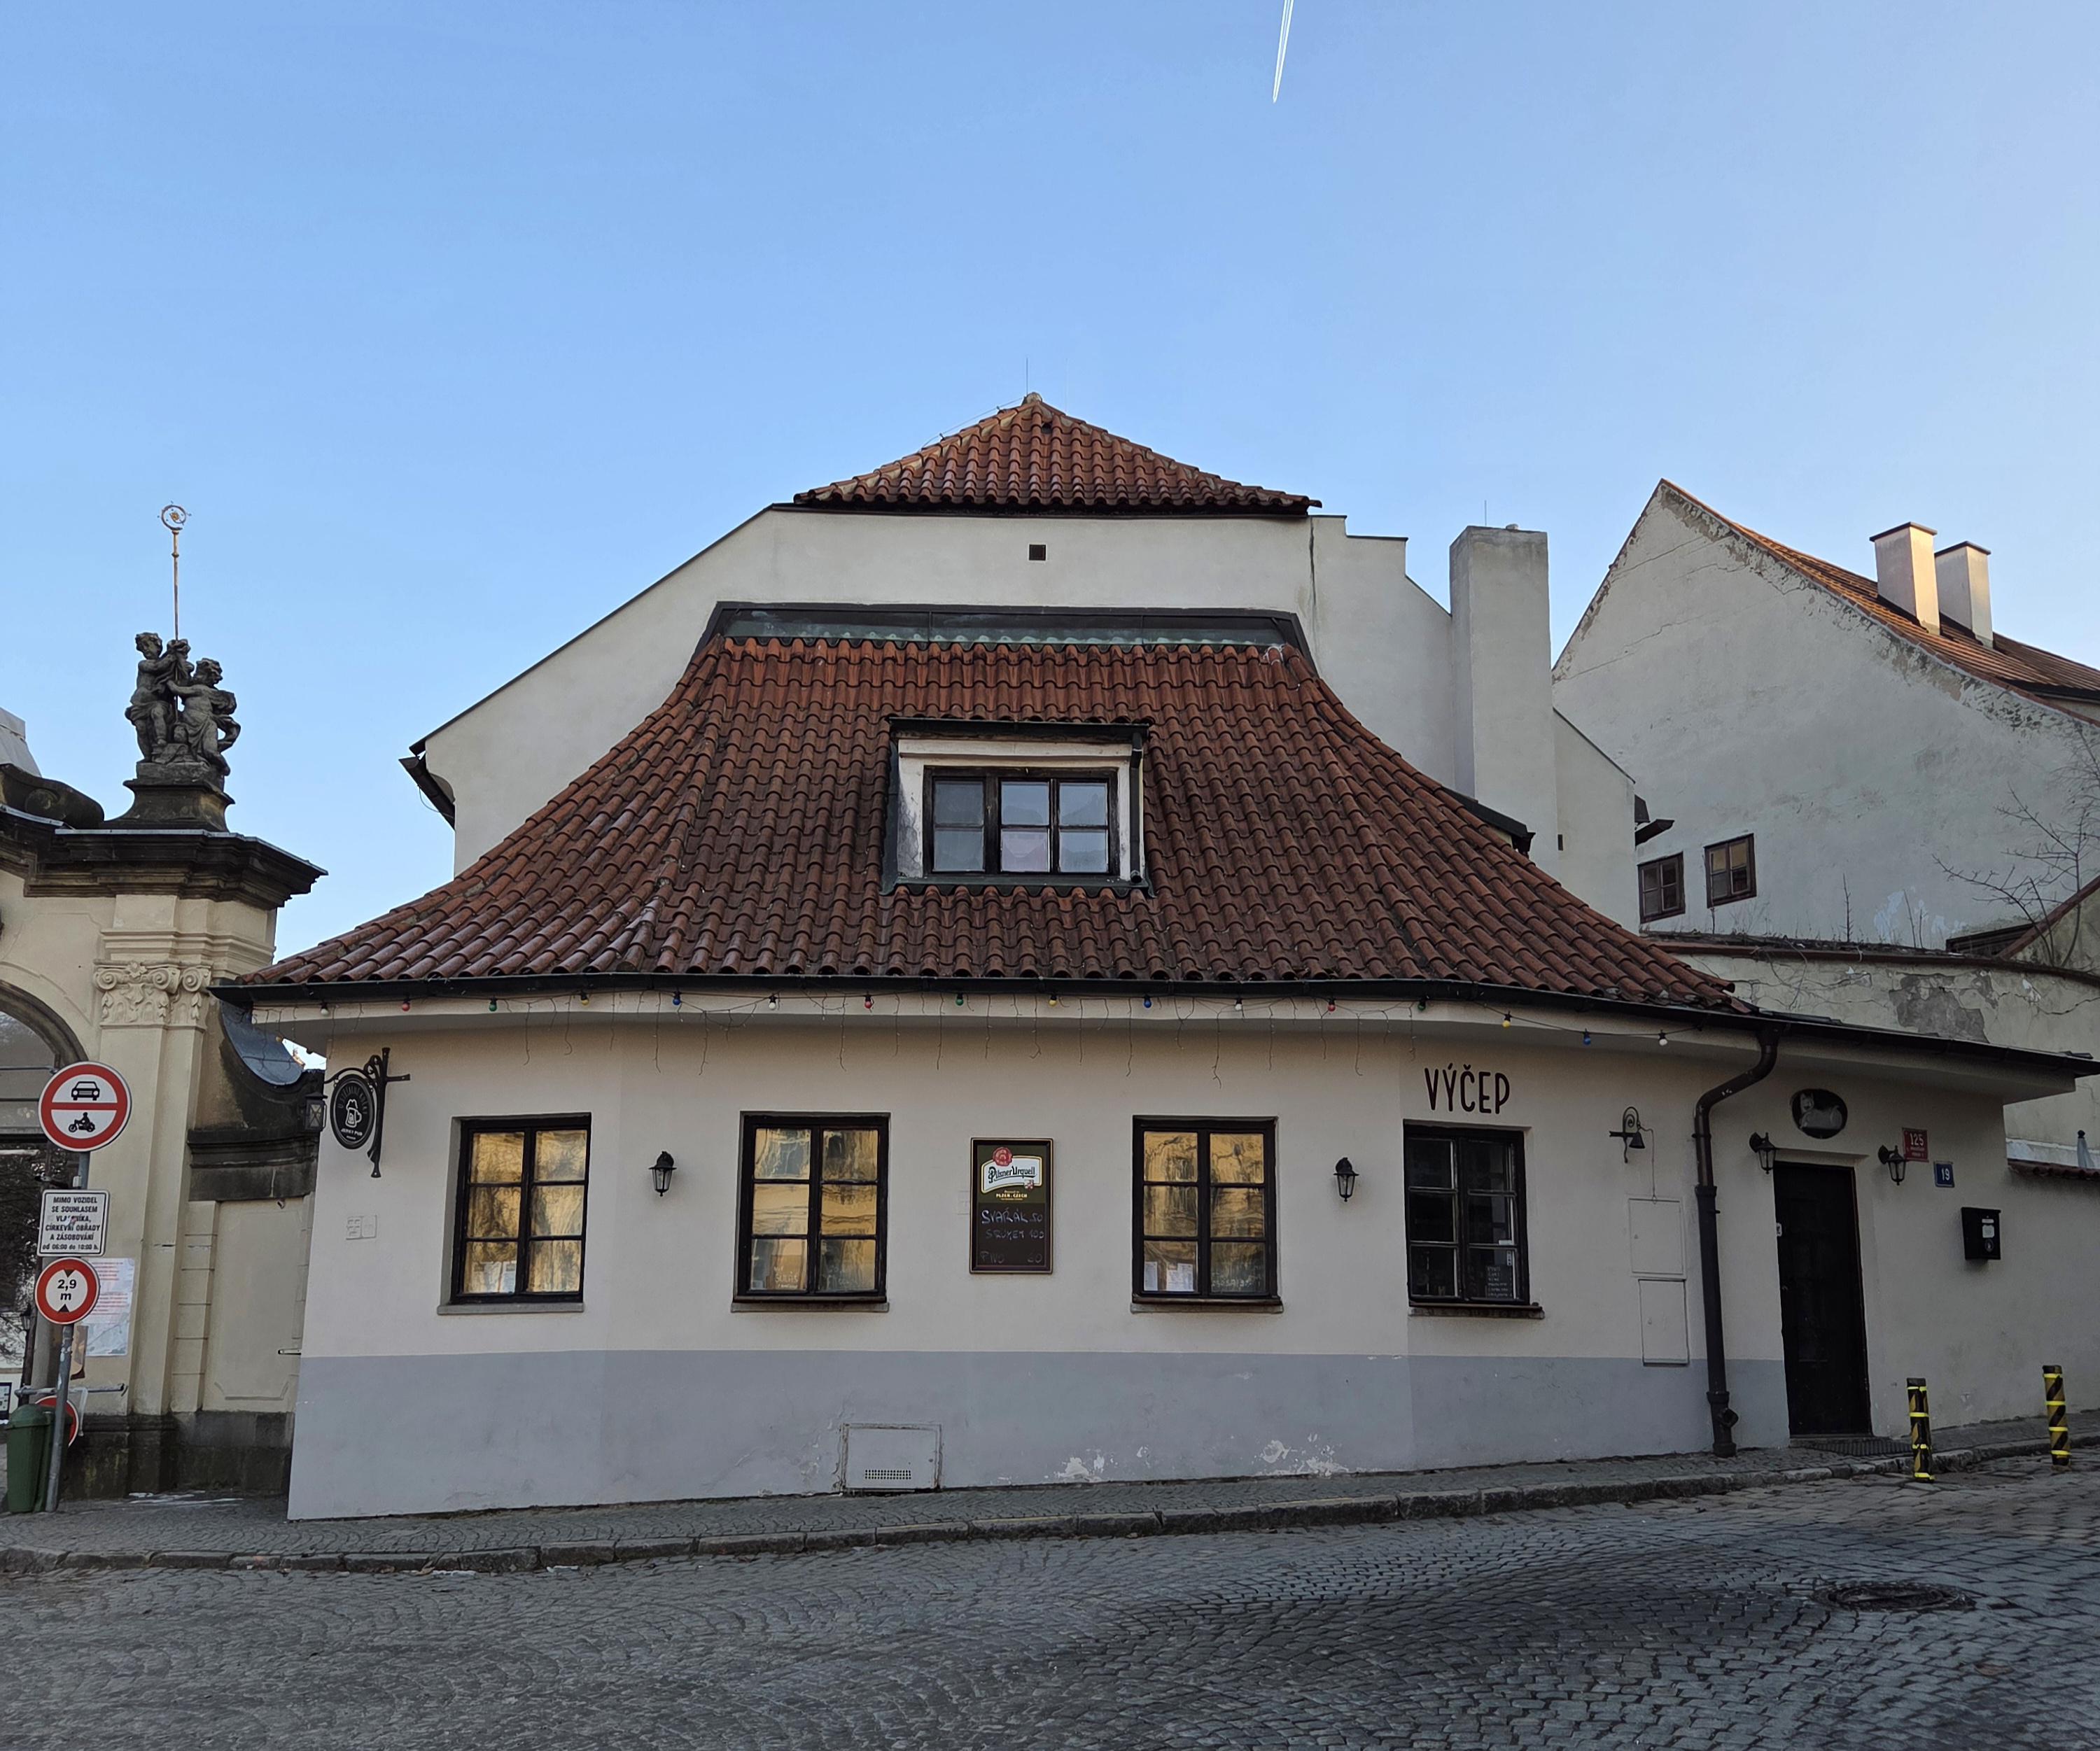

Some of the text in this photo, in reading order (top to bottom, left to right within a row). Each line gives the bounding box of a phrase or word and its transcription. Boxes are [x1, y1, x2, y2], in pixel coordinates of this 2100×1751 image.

[1424, 1062, 1511, 1114] VÝČEP
[1910, 1132, 1924, 1146] 125
[988, 1165, 1036, 1183] Pilsner Urquell
[1941, 1167, 1951, 1181] 19
[76, 1223, 101, 1231] OBŘADY
[56, 1232, 94, 1241] ZÁSOBOVÁNÍ
[57, 1279, 77, 1292] 2,9
